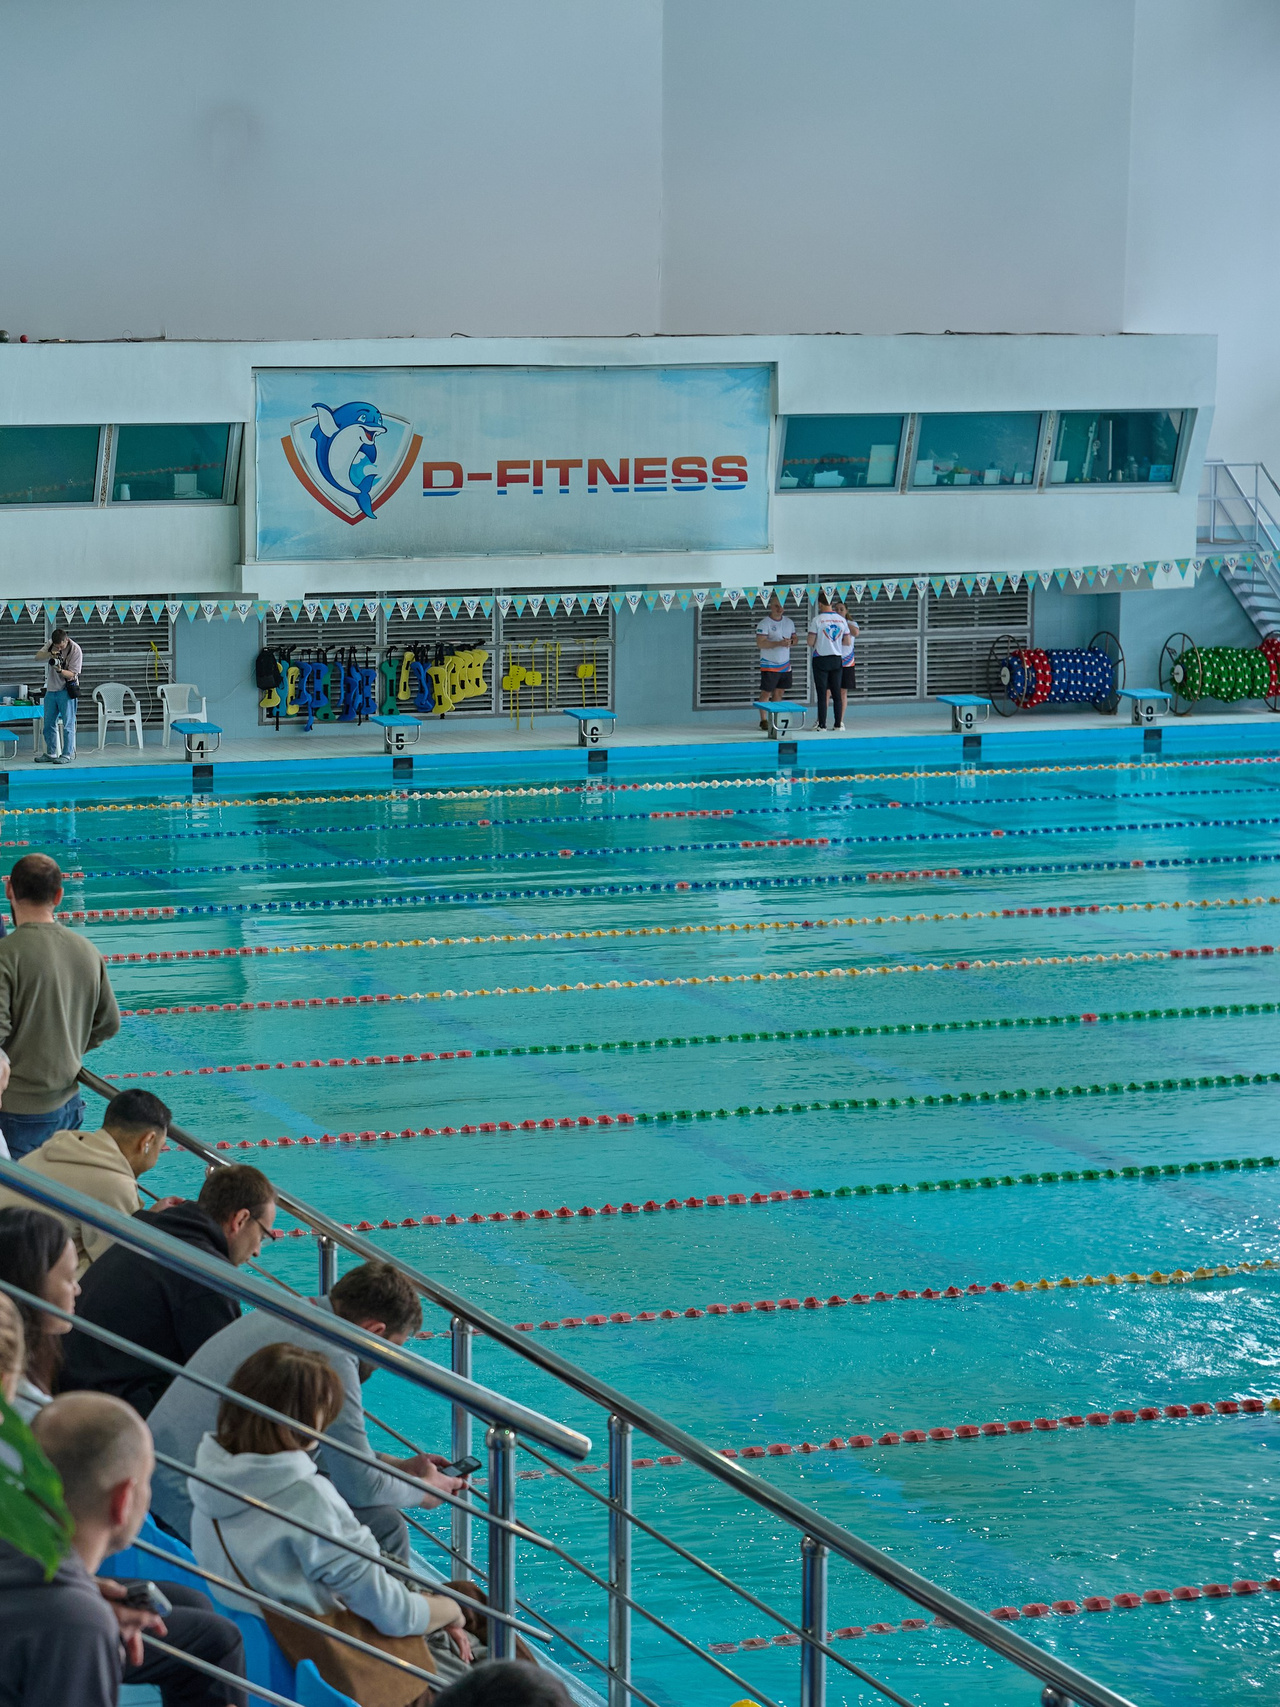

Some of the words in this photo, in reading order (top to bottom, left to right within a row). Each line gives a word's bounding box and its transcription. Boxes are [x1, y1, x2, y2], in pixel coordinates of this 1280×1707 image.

[422, 455, 749, 497] D-FITNESS
[590, 726, 599, 743] 6
[781, 719, 789, 736] 7
[195, 740, 205, 759] 4
[395, 733, 405, 750] 5
